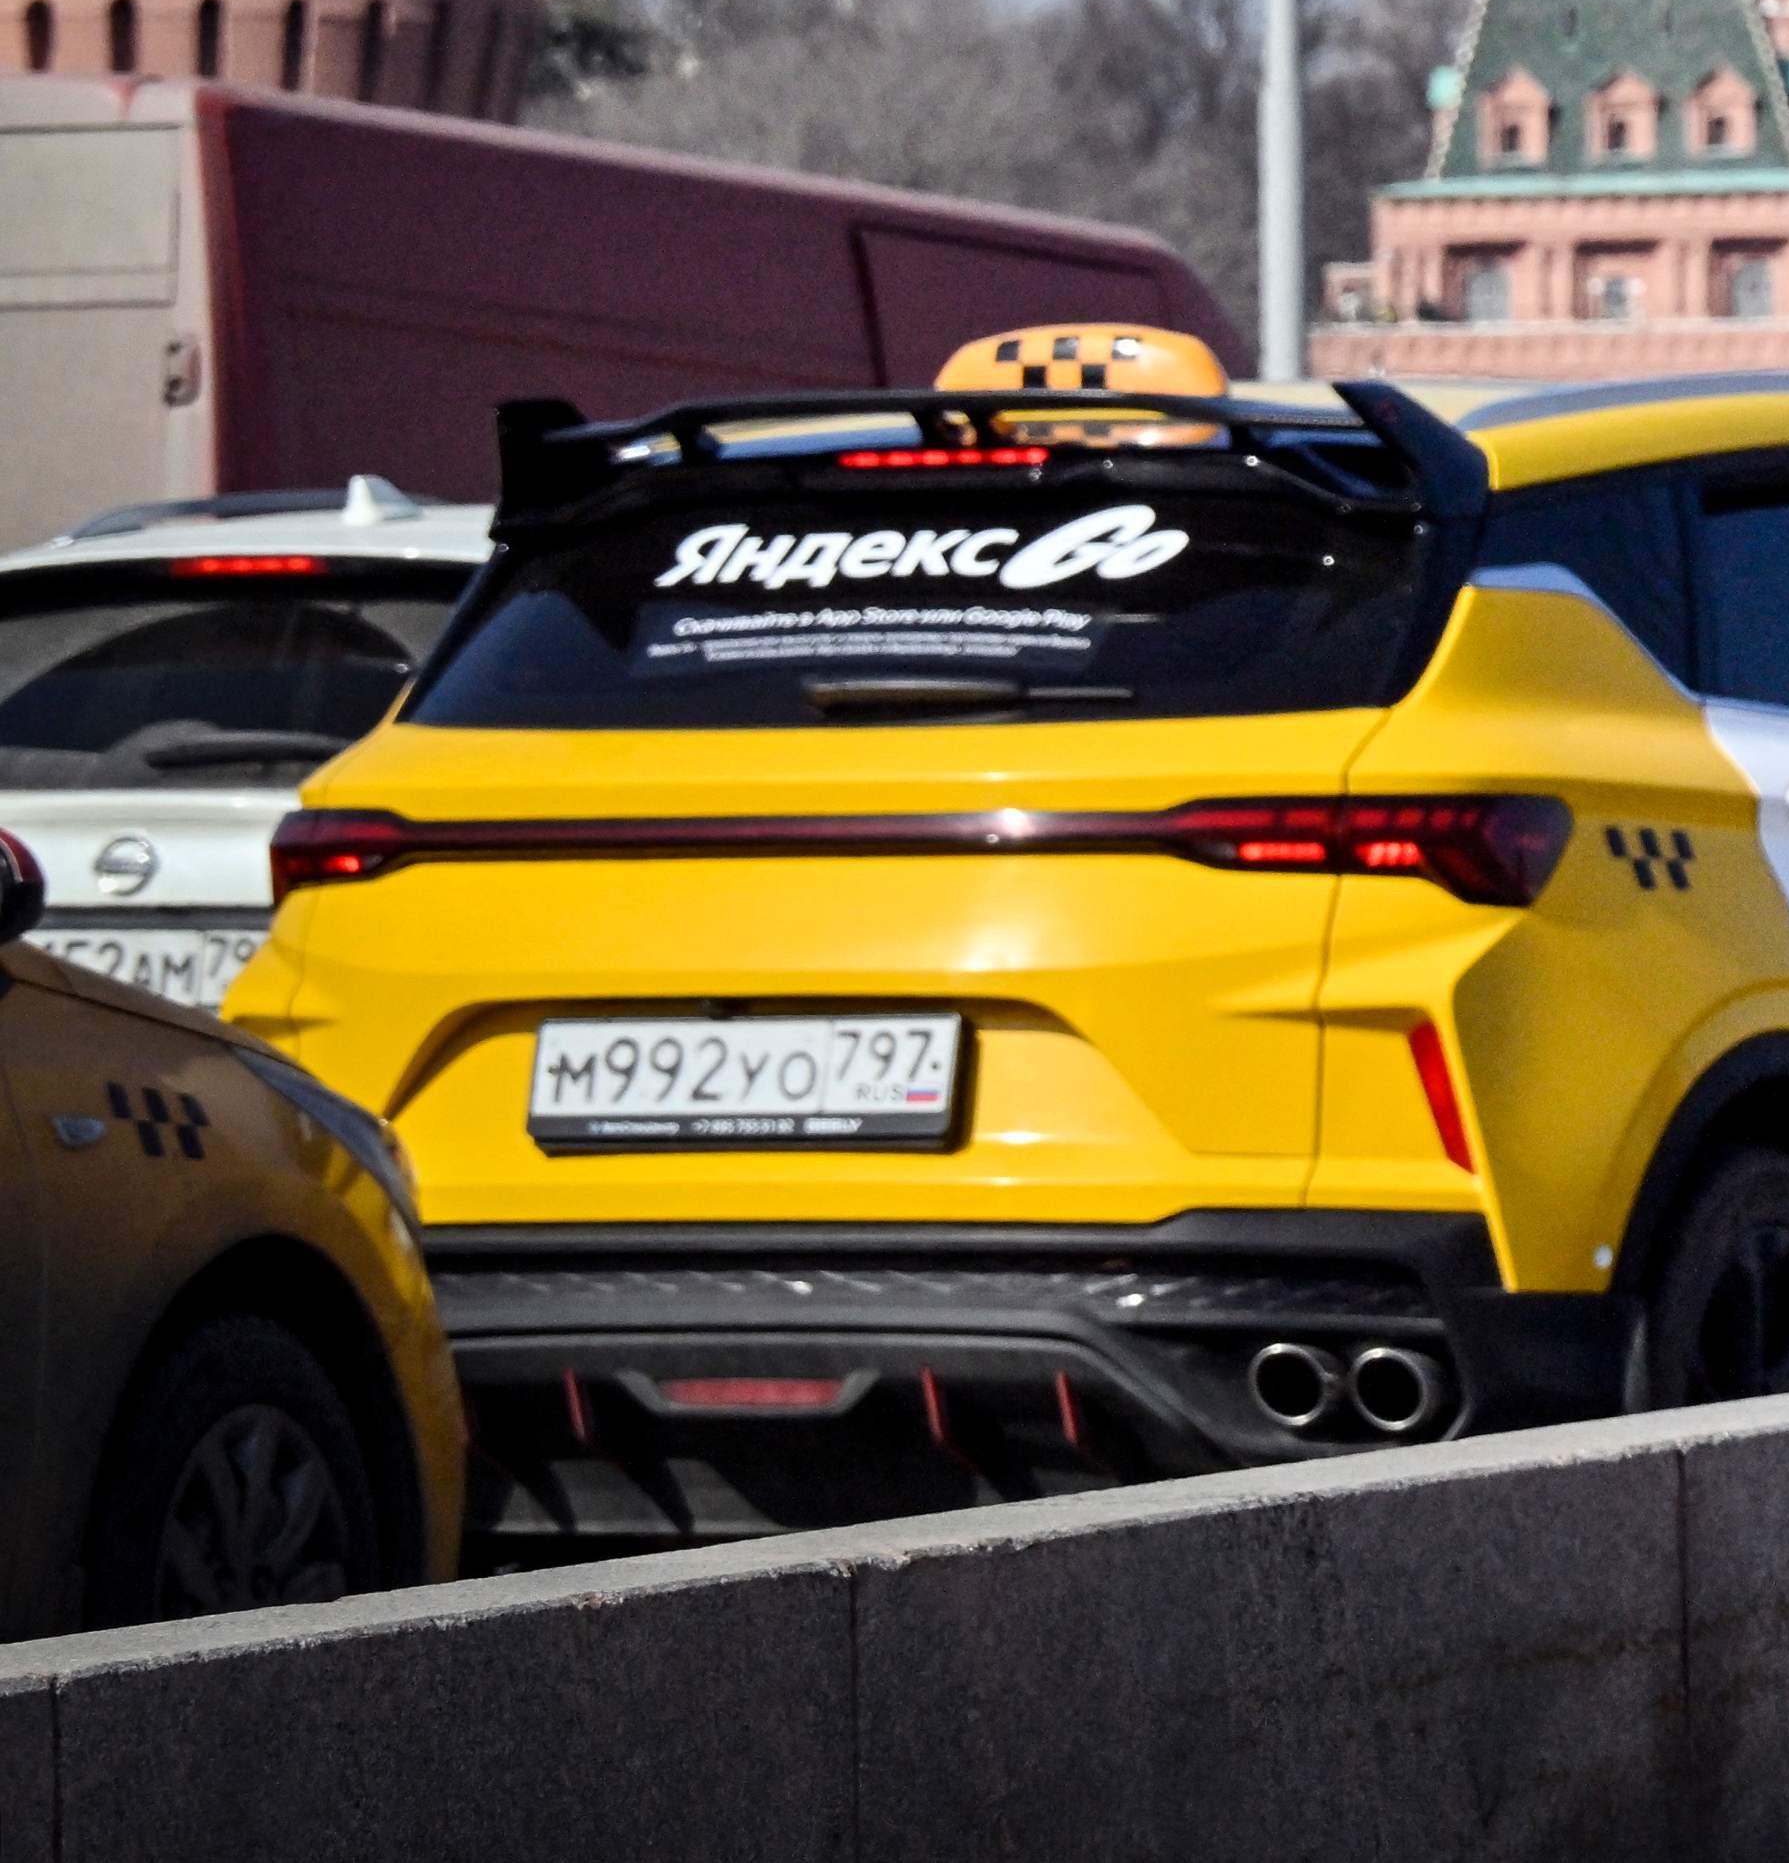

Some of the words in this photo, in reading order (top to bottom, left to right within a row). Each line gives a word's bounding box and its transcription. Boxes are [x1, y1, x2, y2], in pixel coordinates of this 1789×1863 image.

[654, 522, 1019, 589] Яндекс
[999, 504, 1190, 590] Go
[816, 608, 862, 628] App
[862, 606, 921, 625] Store
[963, 606, 1042, 629] Google
[1042, 608, 1093, 632] Play
[834, 1029, 936, 1081] 797
[855, 1082, 904, 1102] RUS
